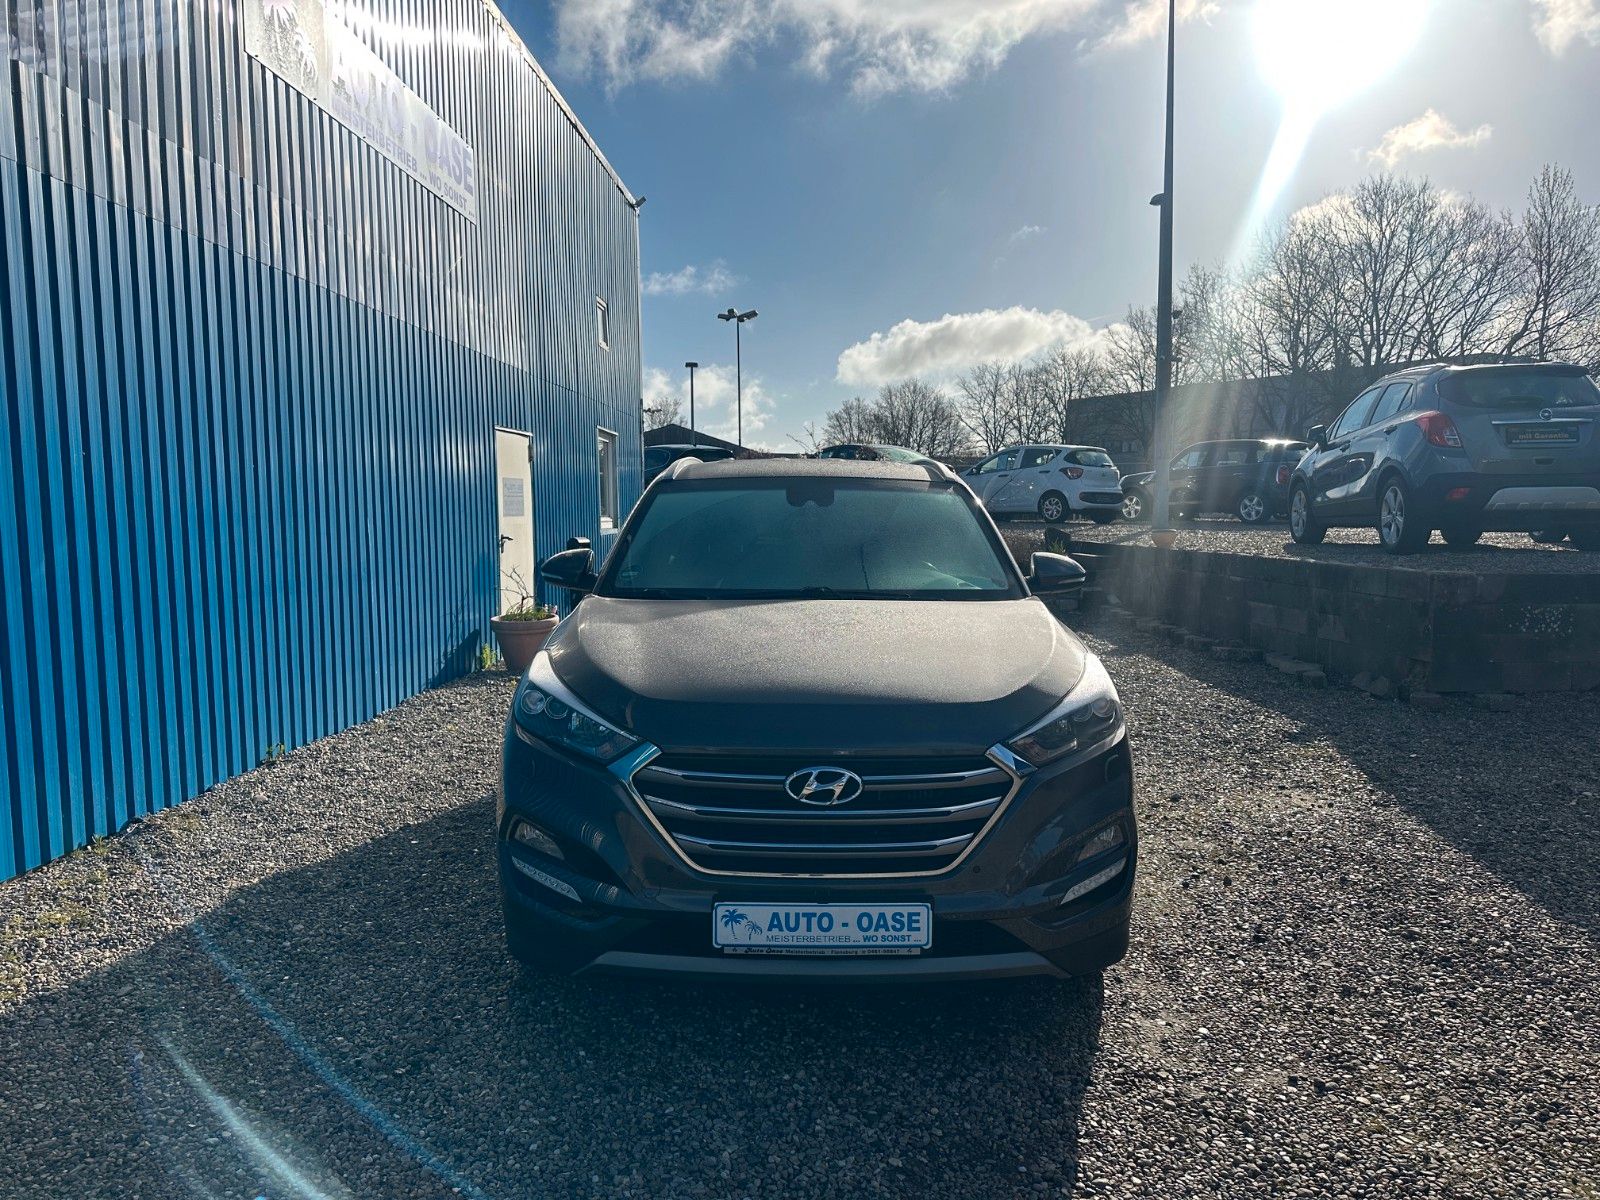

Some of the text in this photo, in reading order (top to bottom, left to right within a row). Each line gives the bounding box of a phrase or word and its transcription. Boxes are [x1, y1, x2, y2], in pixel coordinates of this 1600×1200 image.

[424, 114, 475, 197] OASE
[428, 170, 442, 191] WO
[443, 184, 467, 211] SONST
[767, 911, 834, 933] AUTO
[856, 911, 921, 933] OASE
[766, 935, 851, 943] MEISTERBETRIEB
[862, 934, 878, 943] WO
[880, 934, 911, 943] SONST
